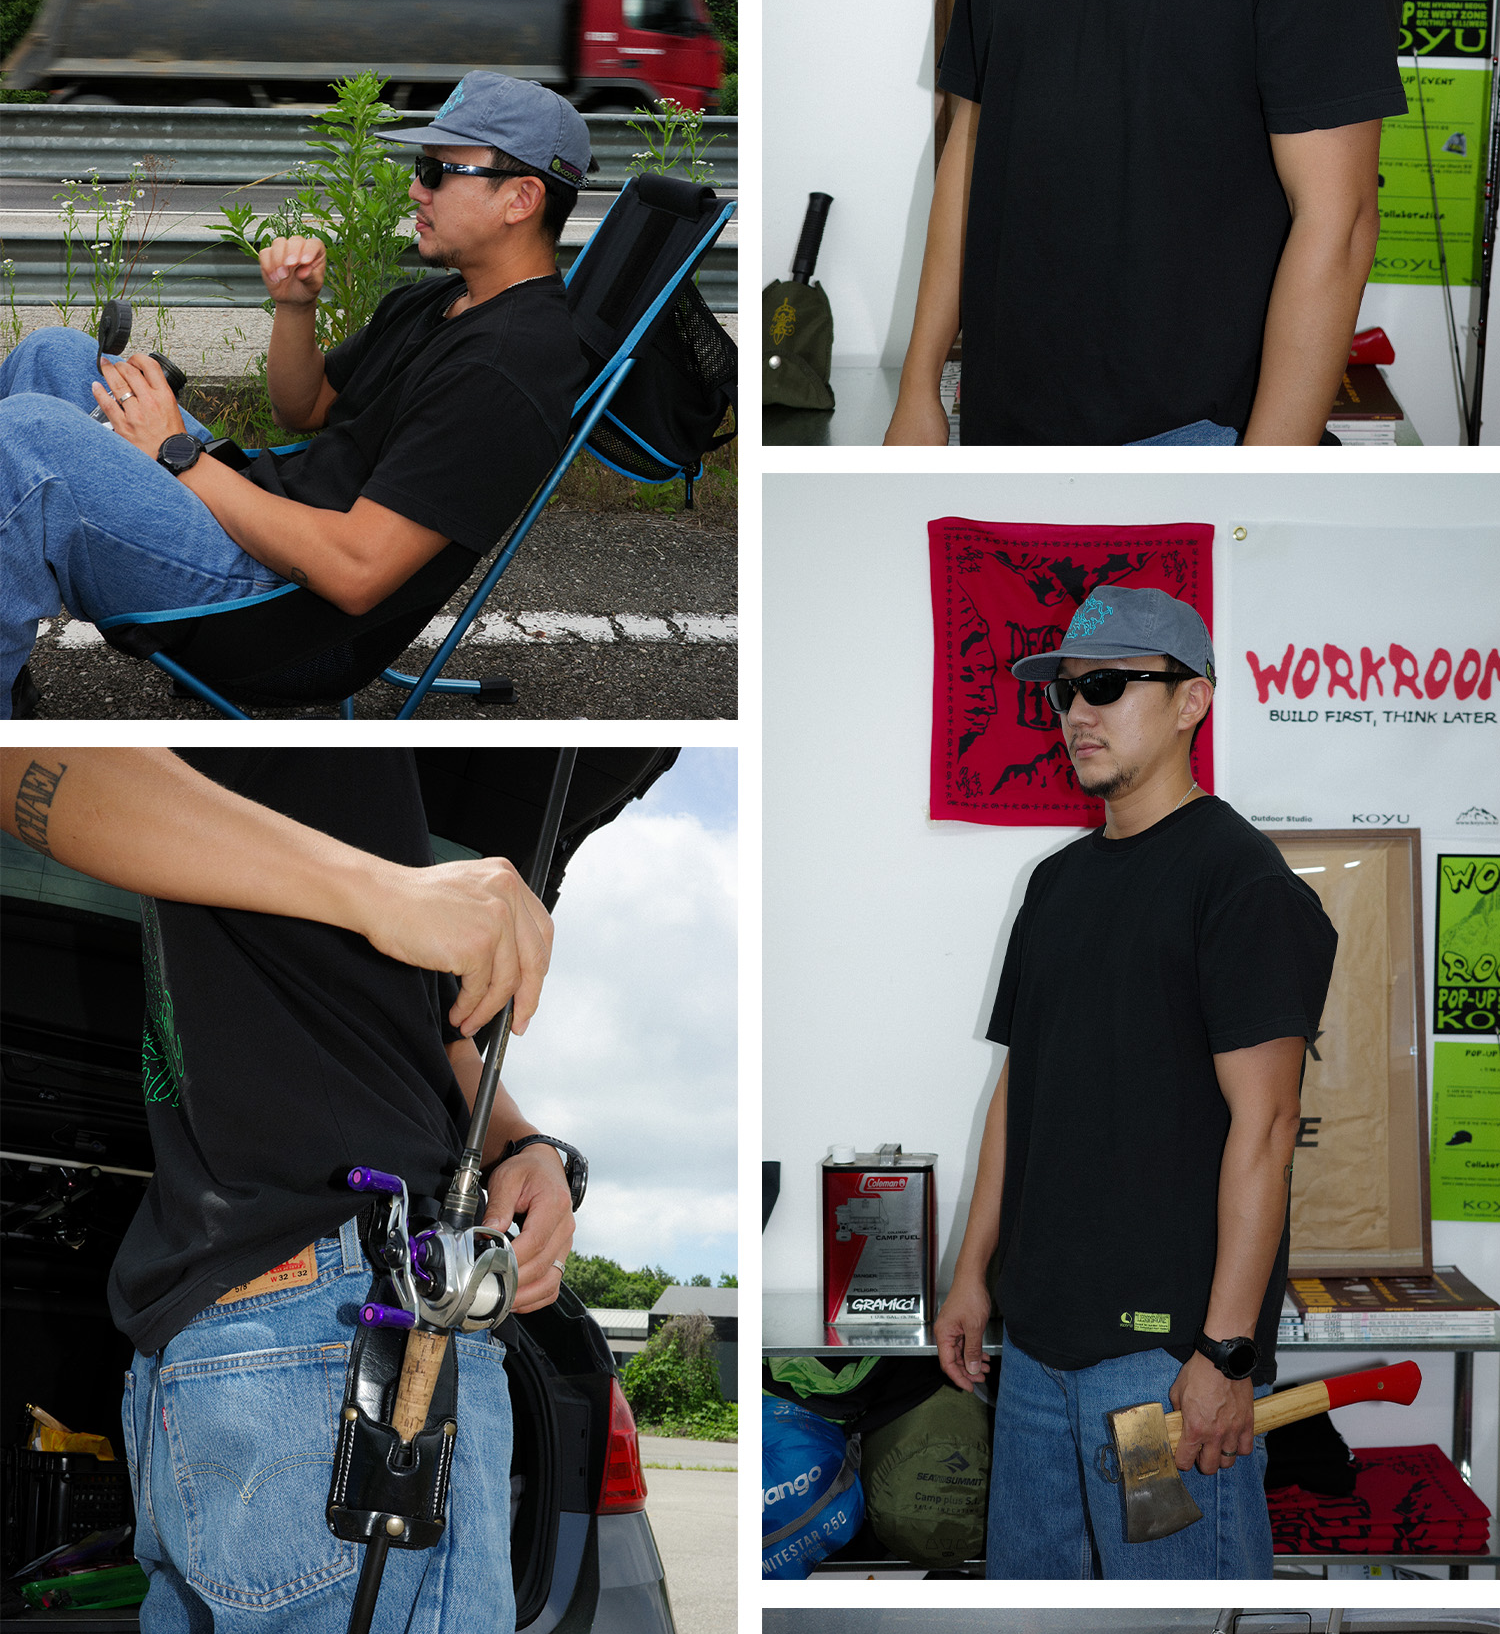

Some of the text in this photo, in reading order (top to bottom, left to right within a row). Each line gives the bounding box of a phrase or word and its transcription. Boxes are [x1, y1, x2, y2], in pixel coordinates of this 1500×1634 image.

[1416, 10, 1487, 19] B2 WEST ZONE
[1421, 76, 1455, 85] EVENT
[1374, 257, 1443, 272] KOYU
[1269, 710, 1498, 727] BUILD FIRST, THINK LATER
[1251, 815, 1313, 823] Outdoor Studio
[1352, 814, 1410, 825] KOYU
[1438, 988, 1497, 1009] POP-UP
[867, 1178, 898, 1188] Coleman
[915, 1492, 942, 1504] Camp
[762, 1510, 848, 1574] NITESTAR 250
